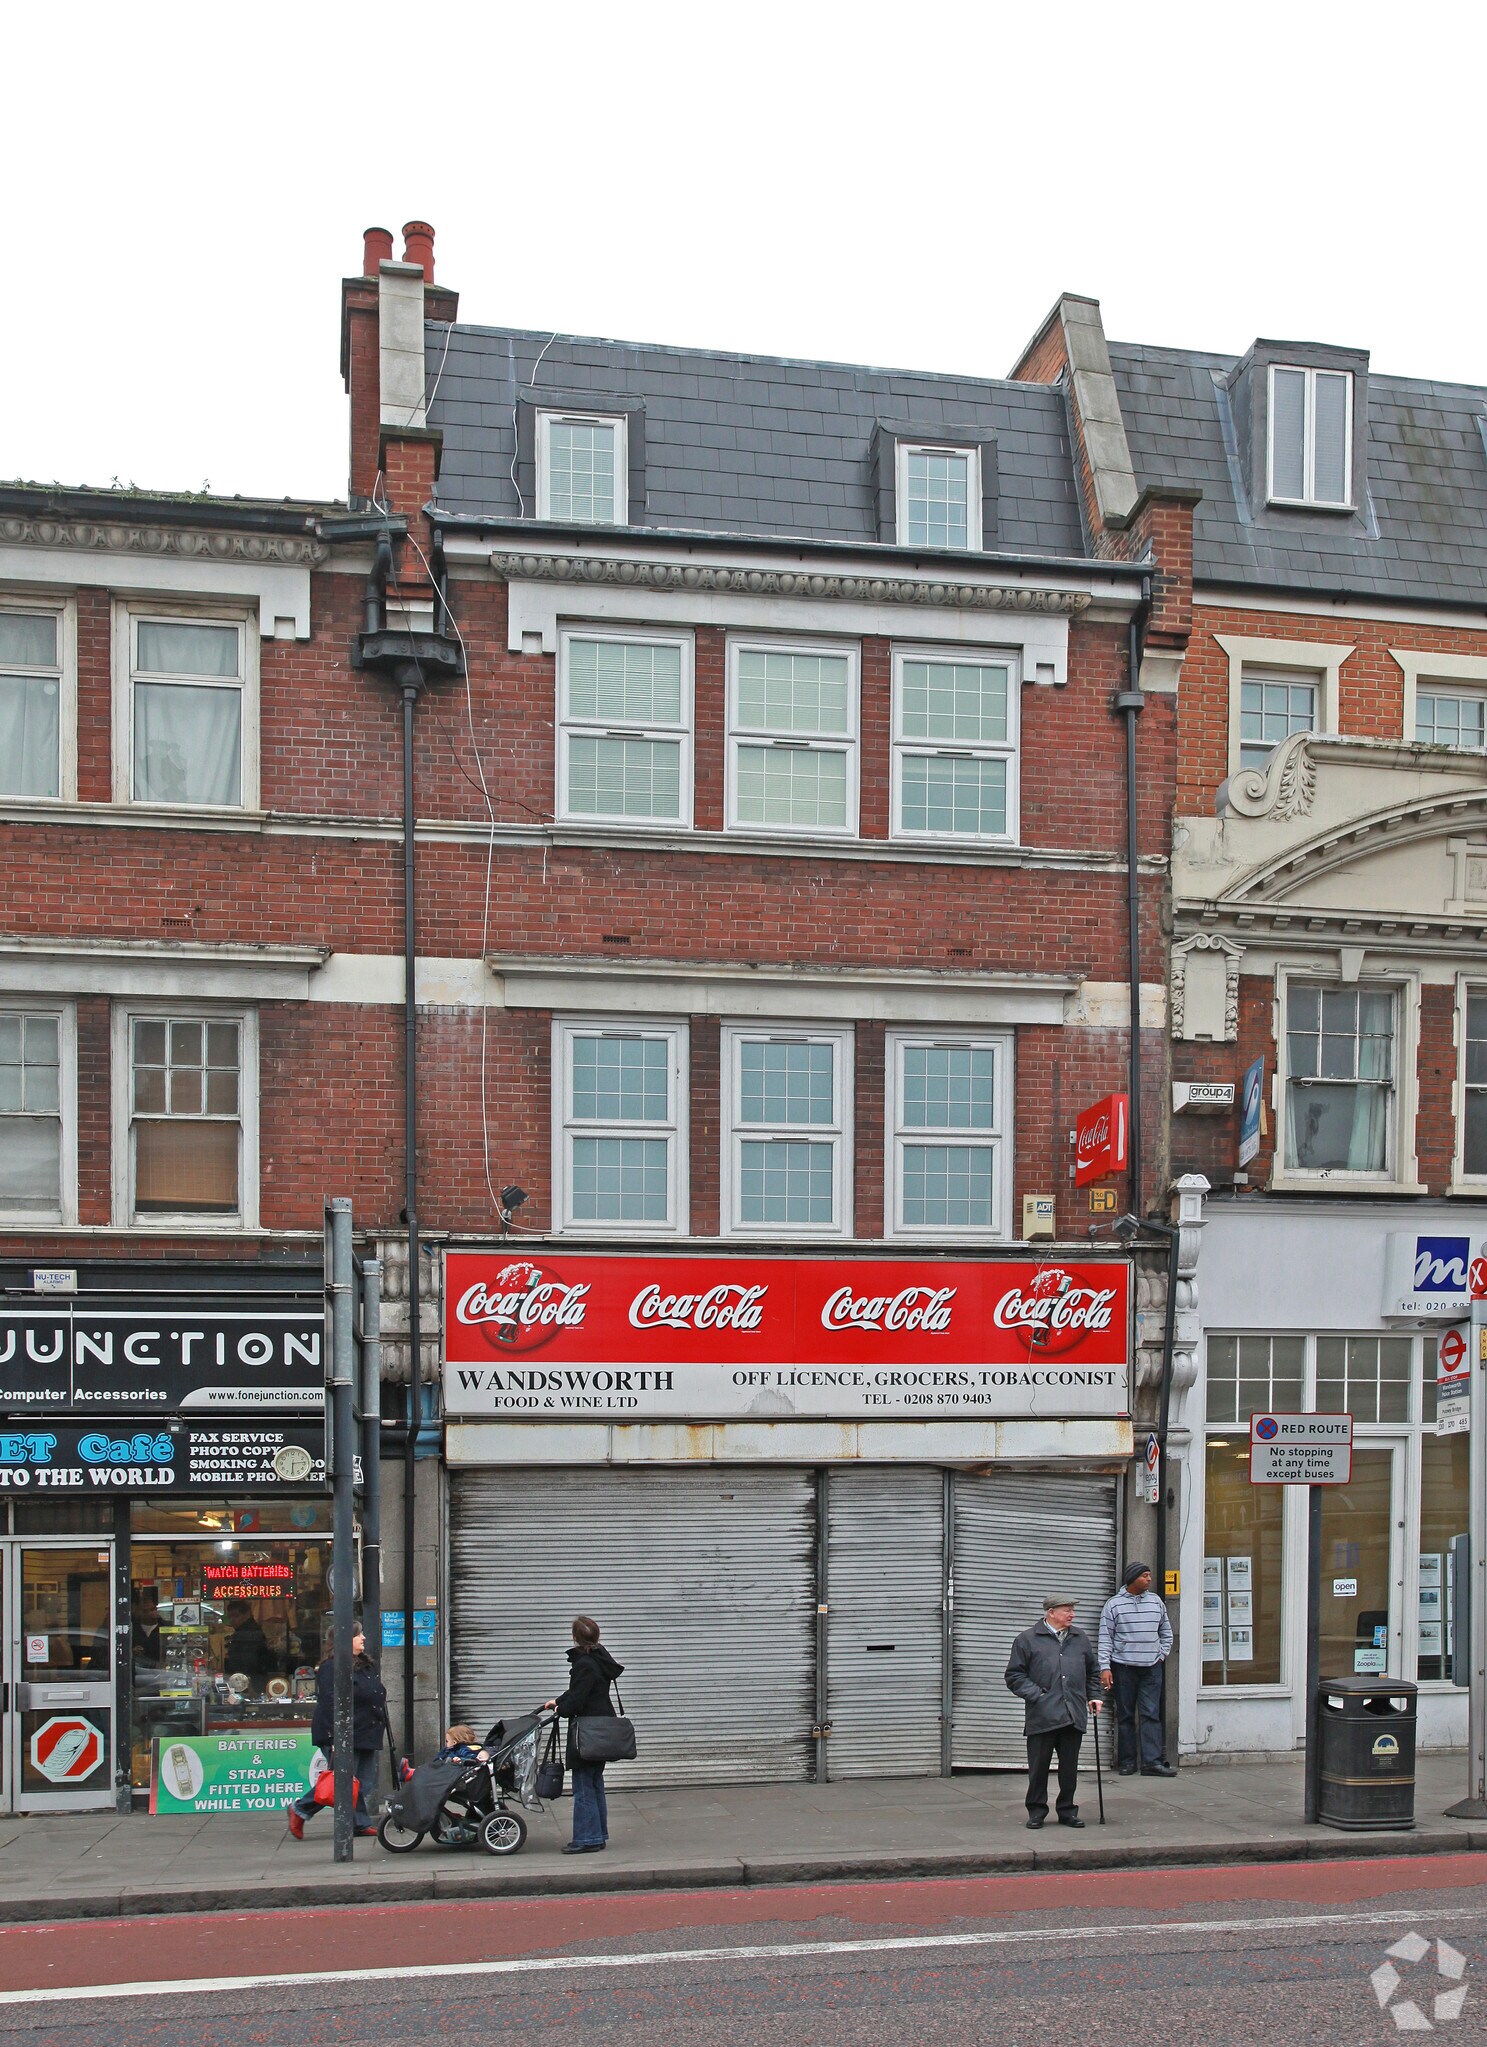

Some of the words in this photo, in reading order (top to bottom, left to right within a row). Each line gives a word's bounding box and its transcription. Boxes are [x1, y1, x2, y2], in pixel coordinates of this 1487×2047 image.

[1190, 1087, 1232, 1098] group4
[1038, 1203, 1052, 1211] ADT
[455, 1282, 592, 1326] Coca-Cola
[628, 1284, 768, 1330] Coca-Cola
[821, 1286, 957, 1331] Coca-Cola
[993, 1288, 1117, 1330] Coca-Cola
[1402, 1302, 1420, 1310] tel:
[457, 1370, 674, 1390] WANDSWORTH
[732, 1372, 770, 1386] OFF
[776, 1372, 870, 1388] LICENCE,
[874, 1372, 974, 1388] GROCERS,
[979, 1372, 1116, 1386] TOBACCONIST
[74, 1388, 168, 1400] Accessories
[208, 1390, 323, 1402] www.fonejunction.com
[862, 1394, 891, 1404] TEL
[904, 1394, 934, 1404] 0208
[937, 1394, 959, 1404] 870
[962, 1394, 992, 1404] 9403
[494, 1396, 538, 1408] FOOD
[544, 1396, 555, 1408] &
[561, 1396, 602, 1408] WINE
[607, 1396, 638, 1408] LTD
[1281, 1424, 1305, 1434] RED
[1309, 1424, 1348, 1434] ROUTE
[190, 1434, 219, 1442] FAX
[222, 1434, 284, 1442] SERVICE
[78, 1433, 174, 1464] Café
[190, 1447, 240, 1455] PHOTO
[1270, 1448, 1286, 1456] No
[1288, 1448, 1333, 1459] stopping
[190, 1460, 257, 1468] SMOKING
[1285, 1460, 1304, 1469] any
[1307, 1458, 1330, 1467] time
[35, 1468, 84, 1486] THE
[88, 1468, 175, 1486] WORLD
[190, 1473, 244, 1482] MOBILE
[1146, 1474, 1157, 1483] epay
[1266, 1470, 1301, 1480] except
[1304, 1470, 1334, 1479] buses
[206, 1566, 238, 1578] WATCH
[241, 1564, 289, 1578] BATTERIES
[213, 1585, 282, 1597] ACCESSORIES
[1335, 1583, 1355, 1592] open
[218, 1740, 297, 1751] BATTERIES
[252, 1755, 262, 1764] &
[229, 1769, 284, 1780] STRAPS
[209, 1784, 260, 1795] FITTED
[265, 1782, 303, 1793] HERE
[194, 1799, 240, 1810] WHILE
[246, 1798, 275, 1808] YOU
